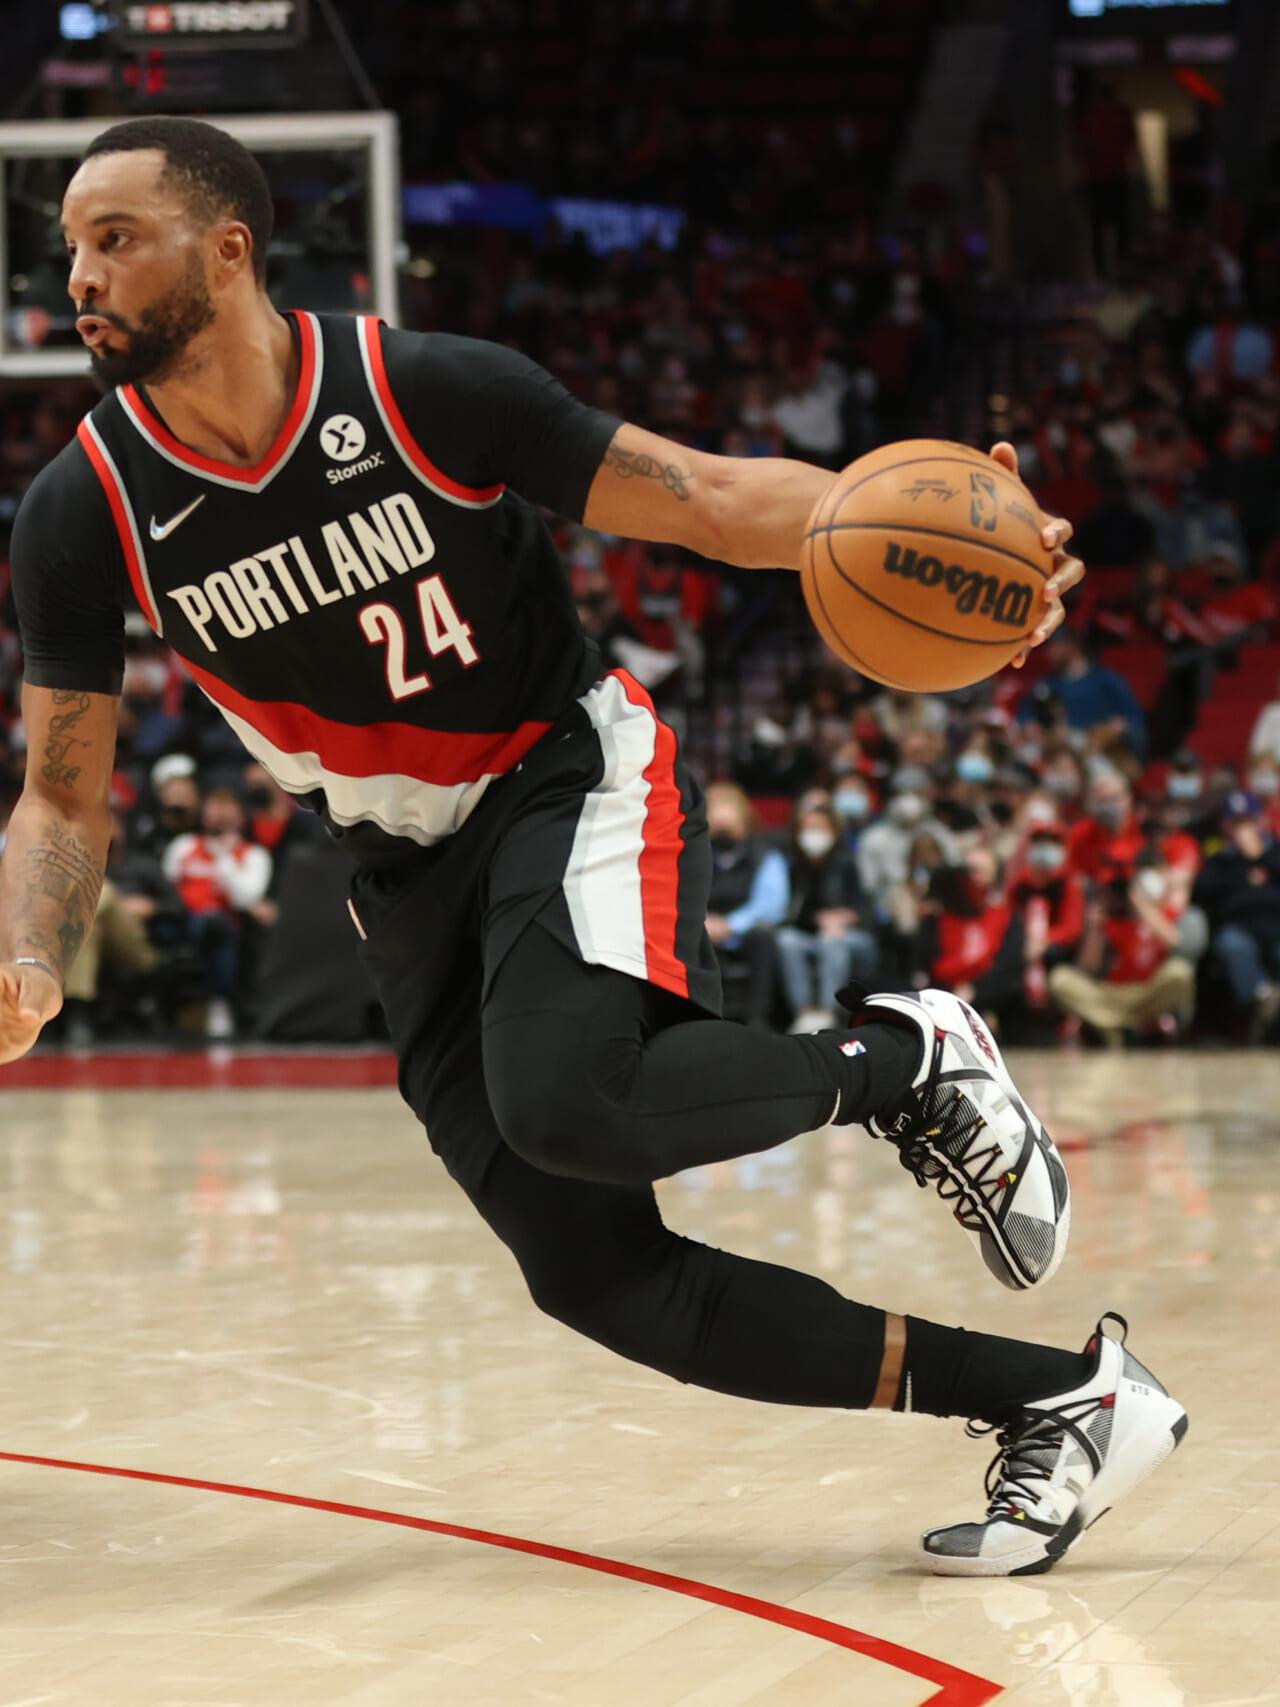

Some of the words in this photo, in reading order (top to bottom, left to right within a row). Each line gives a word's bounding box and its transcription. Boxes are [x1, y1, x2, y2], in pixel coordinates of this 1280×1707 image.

[174, 2, 293, 31] TISSOT
[326, 451, 385, 485] StormX
[166, 492, 436, 652] PORTLAND
[884, 542, 1033, 627] Wilson
[358, 572, 482, 702] 24
